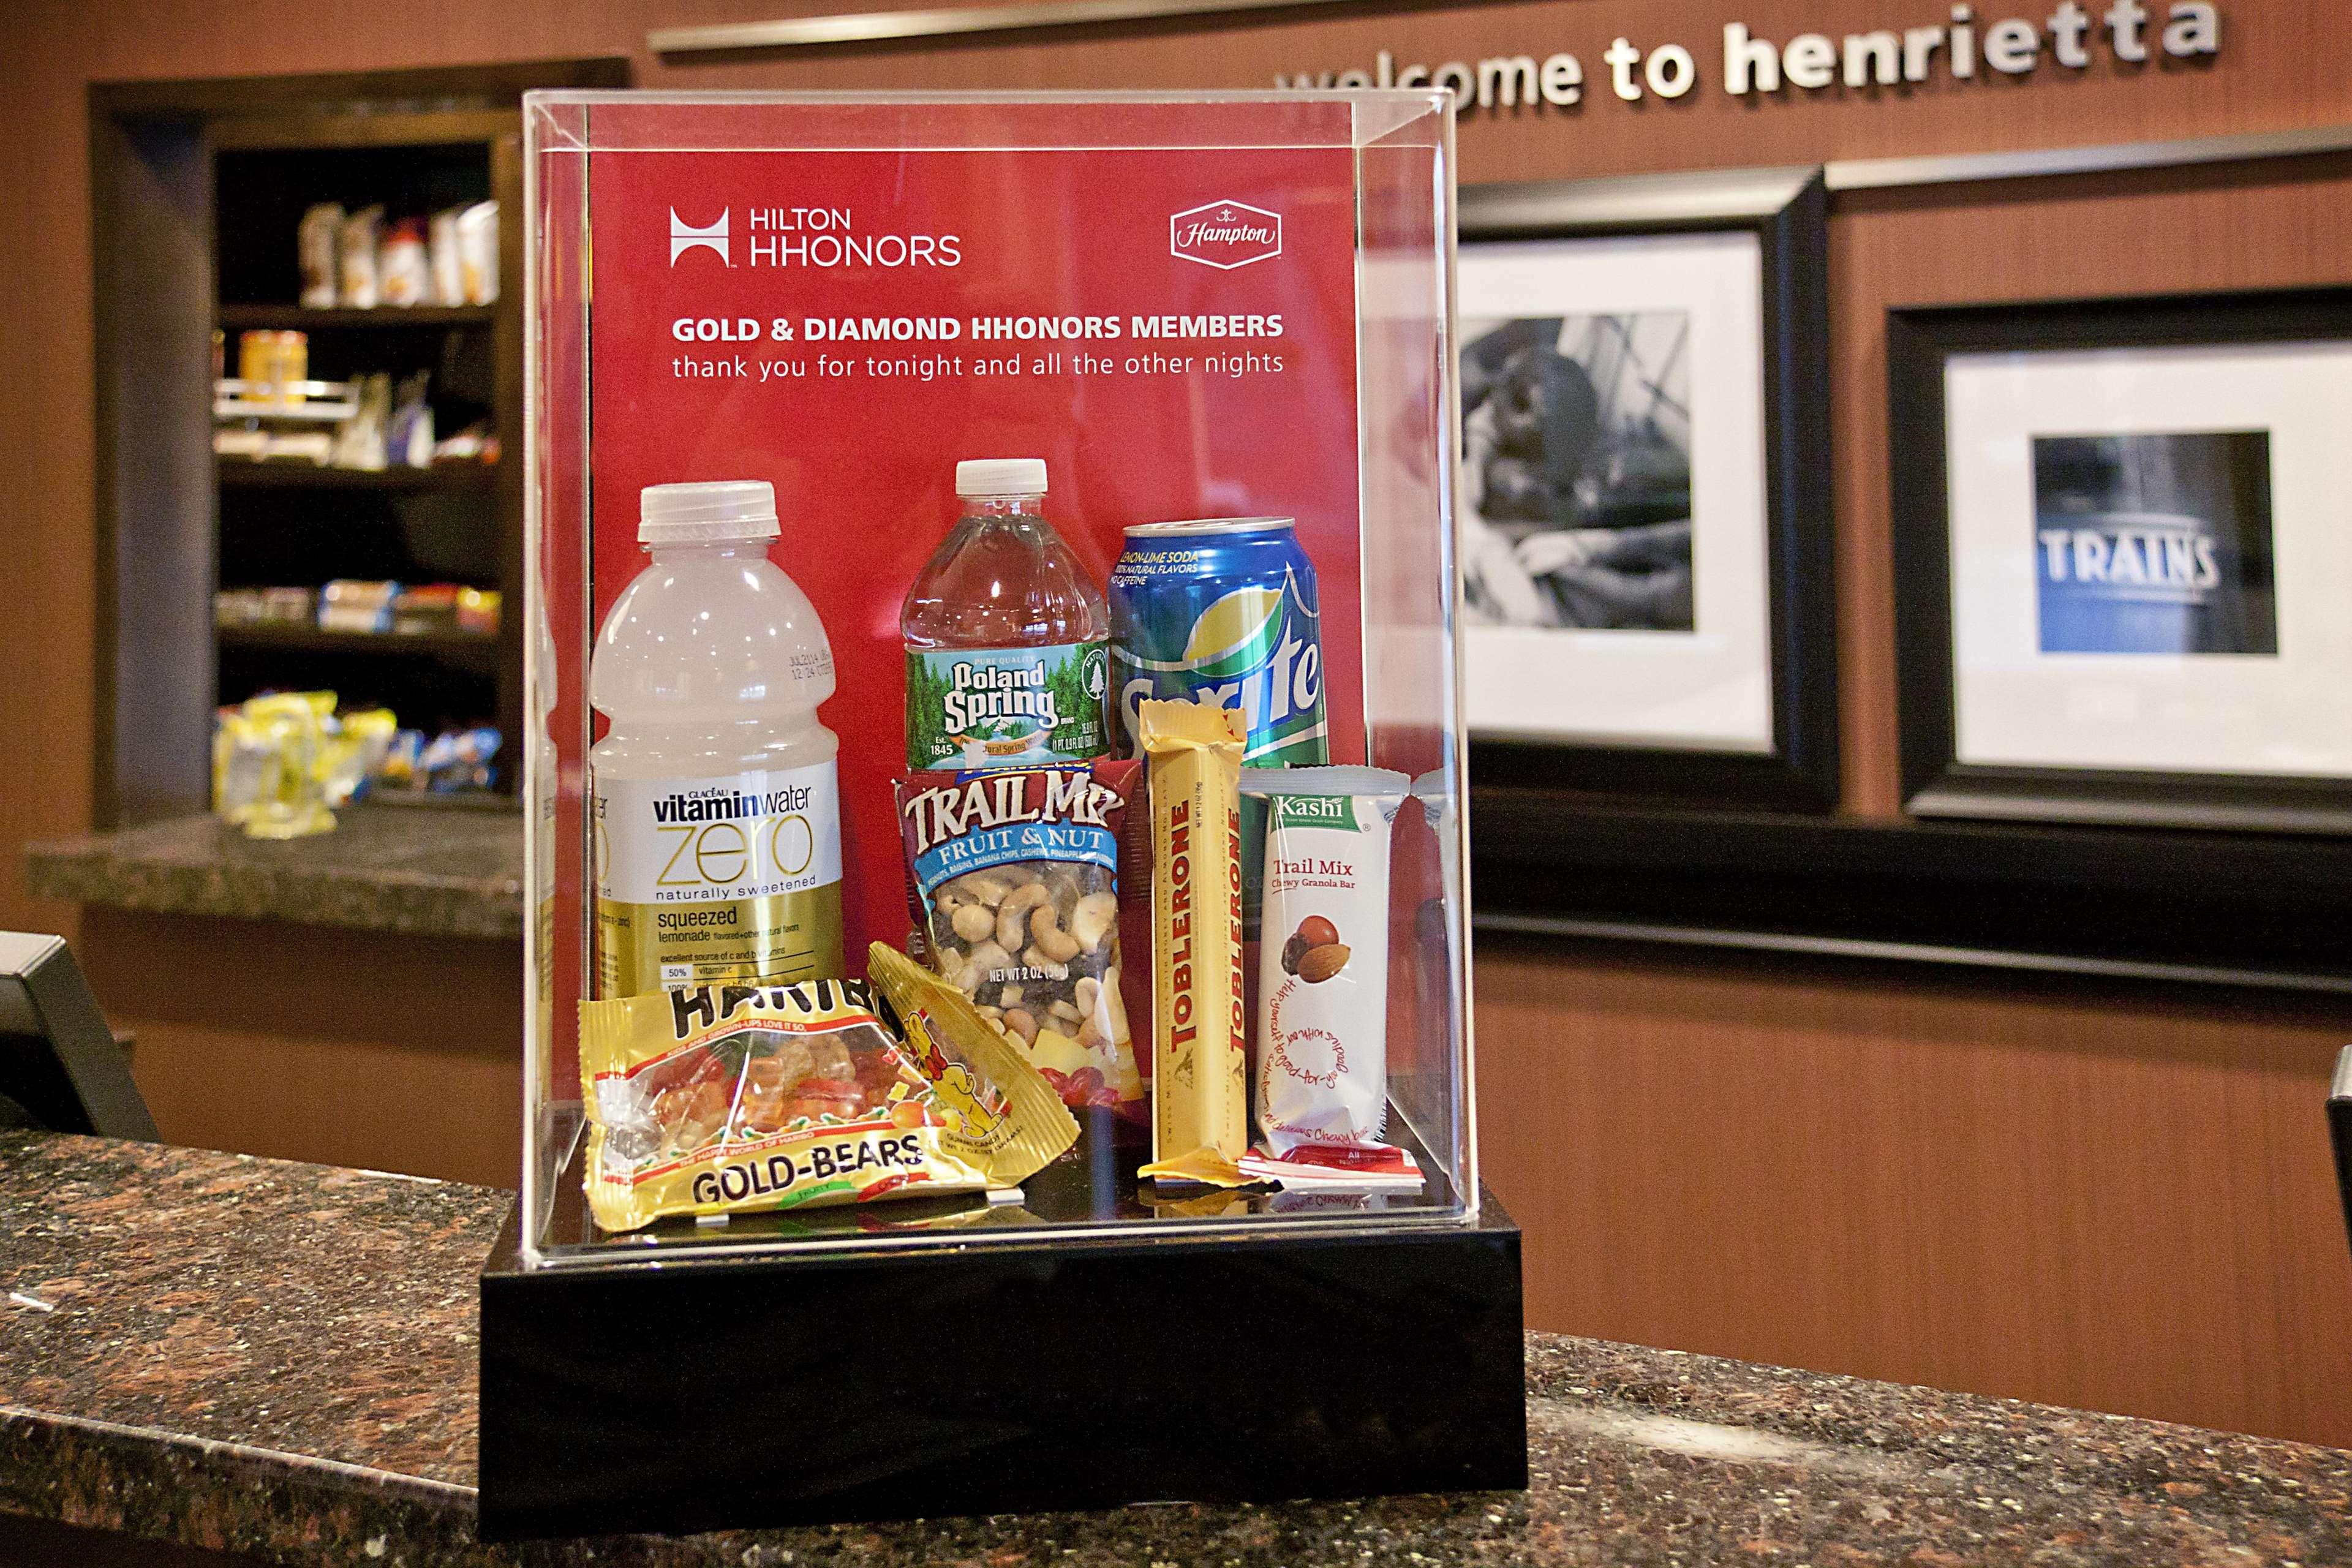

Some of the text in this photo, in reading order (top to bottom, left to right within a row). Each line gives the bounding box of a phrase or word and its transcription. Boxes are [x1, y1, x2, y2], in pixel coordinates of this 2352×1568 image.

[1604, 36, 1695, 100] to
[1722, 0, 2219, 95] henrietta
[750, 208, 851, 231] HILTON
[1177, 221, 1276, 247] Hampton
[750, 235, 962, 268] HHONORS
[672, 314, 1283, 342] GOLD & DIAMOND HHONORS MEMBERS
[673, 351, 1284, 382] thank you for tonight and all the other nights
[1120, 551, 1199, 563] LEMON-LIME SODA
[1126, 565, 1156, 574] NATURAL
[1158, 564, 1199, 574] FLAVORS
[2038, 528, 2221, 589] TRAINS
[1117, 576, 1148, 585] CAFFEINE
[999, 656, 1036, 665] QUALITY
[952, 660, 1046, 690] Poland
[1122, 615, 1320, 760] Site
[944, 686, 1059, 734] Spring
[930, 745, 953, 755] 1845
[1003, 742, 1026, 754] Spring
[654, 785, 812, 822] vitaminwater
[688, 788, 729, 799] GLACÉAU
[905, 770, 1125, 855] TRAIL MIX
[1276, 796, 1343, 817] Kashi
[656, 814, 813, 886] zero
[938, 827, 1103, 865] FRUIT & NUT
[1273, 858, 1353, 876] Trail Mix
[656, 875, 816, 900] naturally sweetened
[1272, 879, 1355, 889] Chewy Granola Bar
[658, 907, 737, 930] squeezed
[1170, 799, 1197, 1054] TOBLERONE
[1228, 807, 1245, 1054] TOBLERONE
[658, 930, 711, 943] lemonade
[660, 953, 693, 963] excellent
[695, 952, 719, 962] source
[720, 951, 729, 960] of
[736, 951, 750, 959] and
[669, 968, 687, 977] 50%
[990, 963, 1069, 982] NET WT 2 OZ (56g)
[1276, 979, 1296, 1002] Help
[707, 1019, 763, 1042] GROWN-UPS
[763, 1020, 783, 1030] LOVE
[793, 1023, 807, 1032] SO.
[1270, 998, 1284, 1042] yourself
[1325, 1031, 1349, 1074] goodies
[698, 1148, 729, 1161] HAPPY
[729, 1144, 764, 1156] WORLD
[779, 1131, 815, 1144] HARIBO
[693, 1135, 922, 1204] GOLD-BEARS
